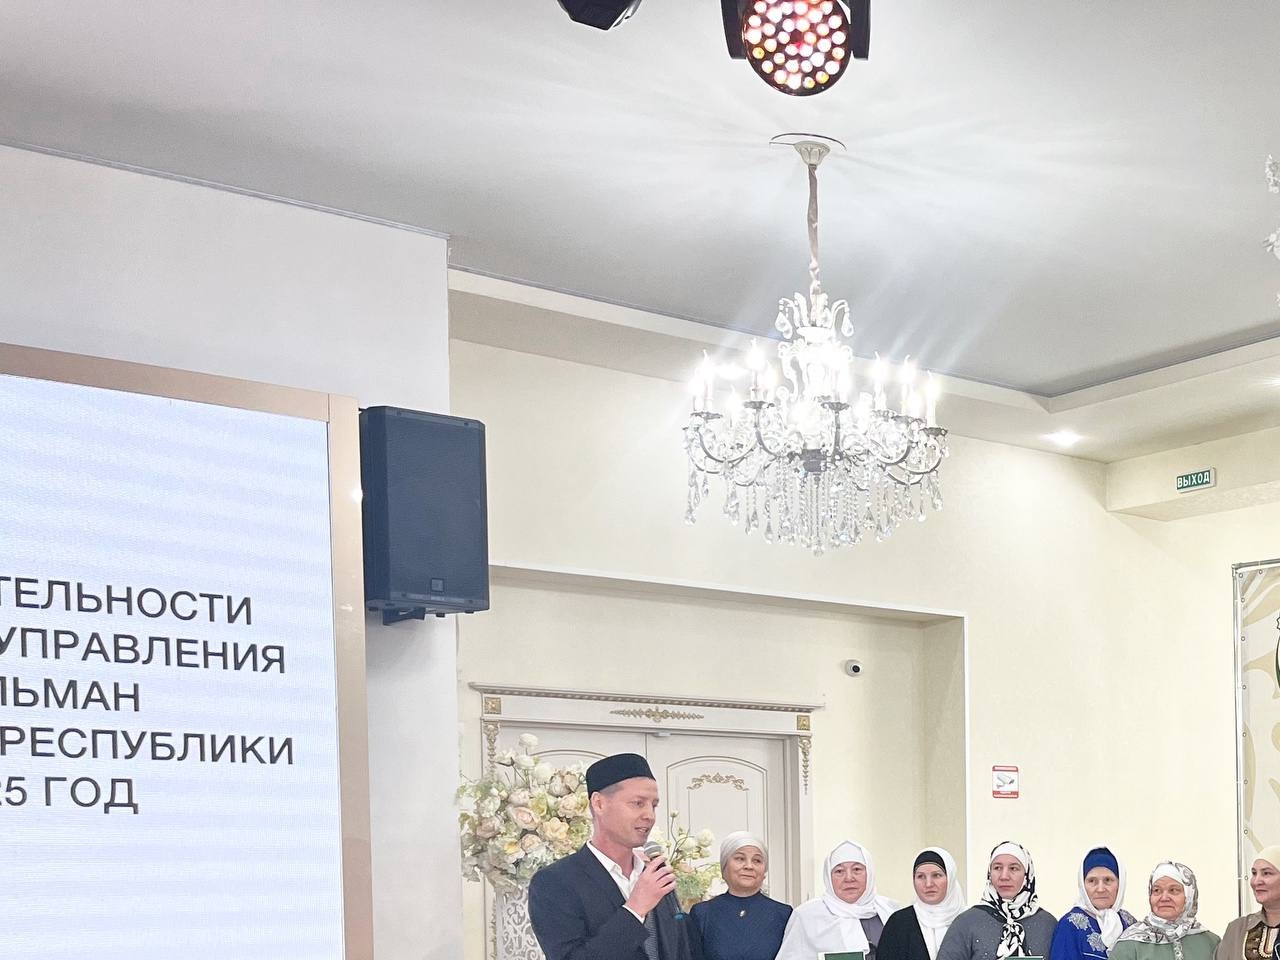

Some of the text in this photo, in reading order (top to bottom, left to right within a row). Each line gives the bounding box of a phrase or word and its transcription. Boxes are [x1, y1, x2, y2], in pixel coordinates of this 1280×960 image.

[1177, 471, 1210, 488] ВЫХОД
[0, 626, 286, 674] УПРАВЛЕНИЯ
[0, 676, 140, 712] ЬМАН
[0, 726, 294, 765] РЕСПУБЛИКИ
[0, 776, 139, 815] 5 ГОД
